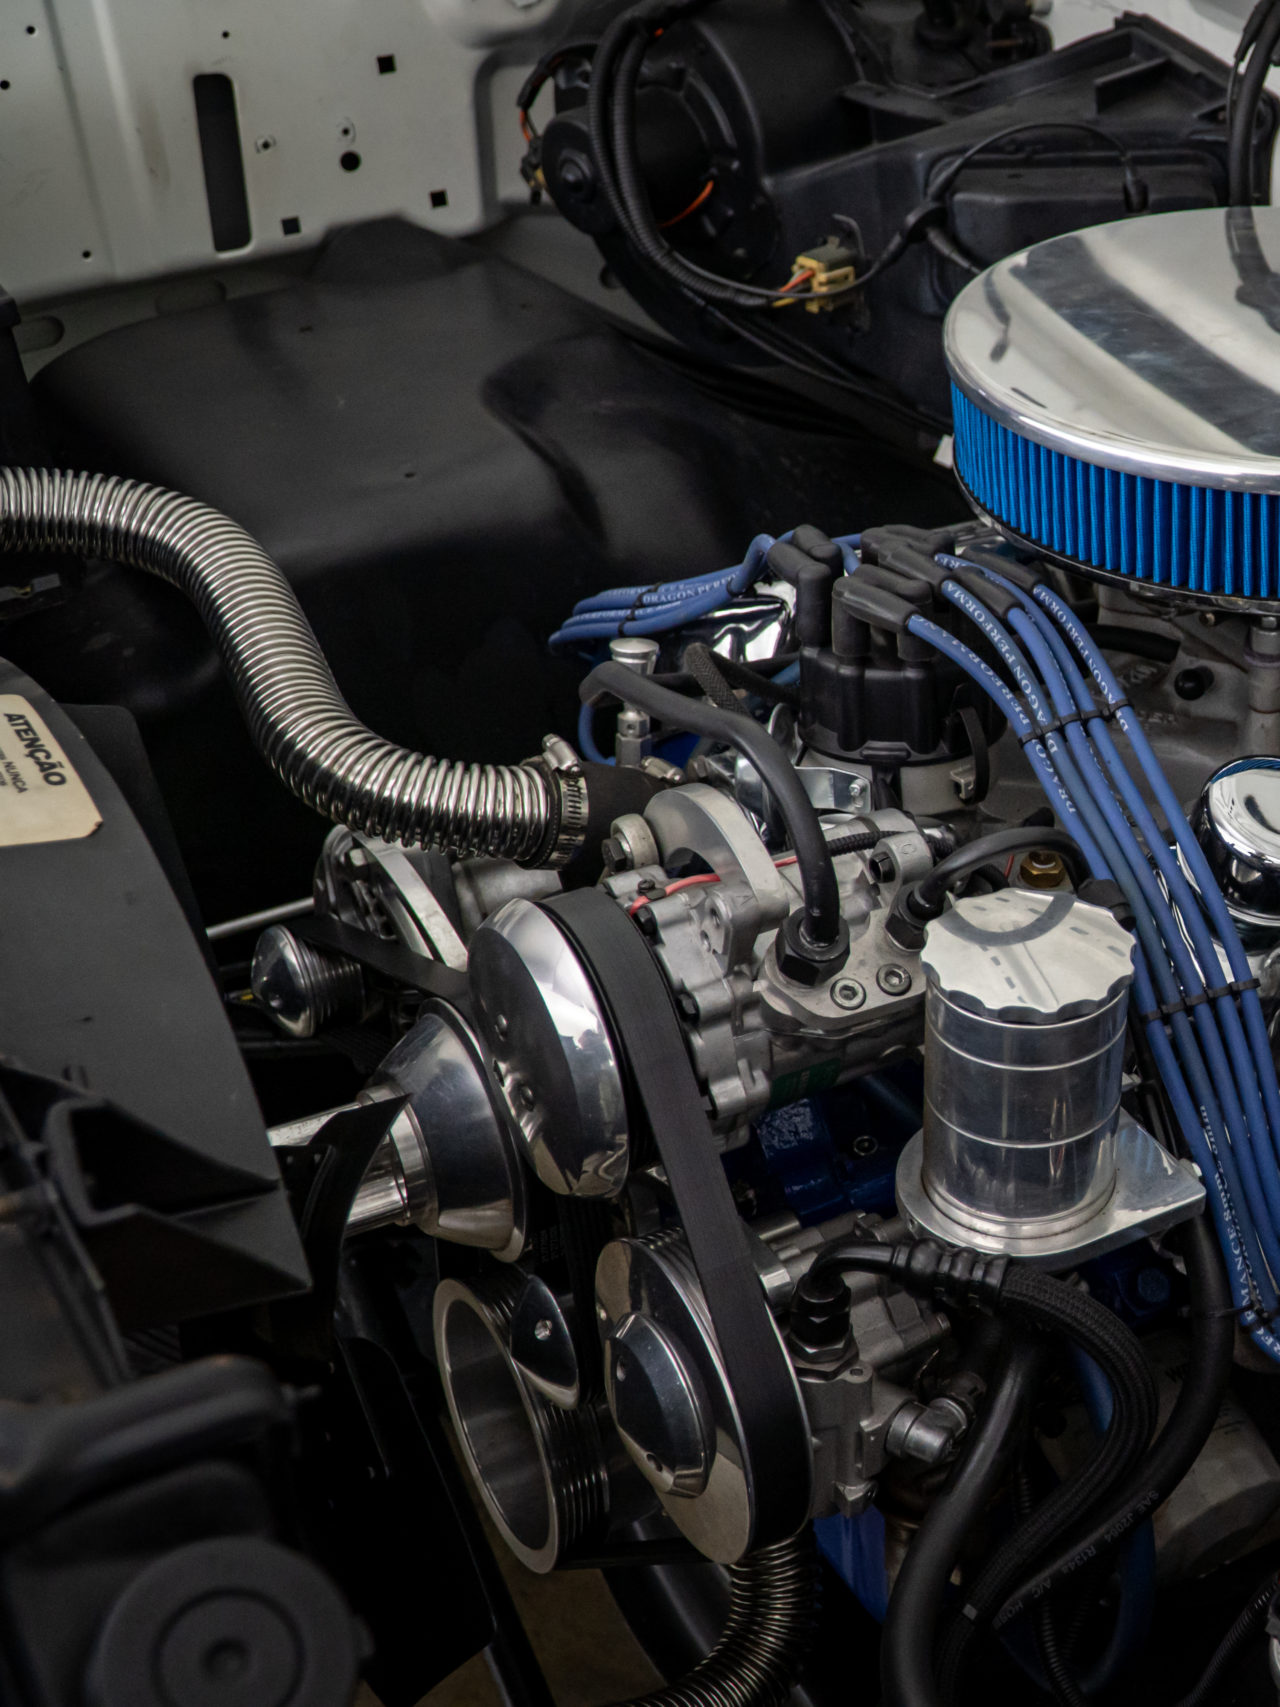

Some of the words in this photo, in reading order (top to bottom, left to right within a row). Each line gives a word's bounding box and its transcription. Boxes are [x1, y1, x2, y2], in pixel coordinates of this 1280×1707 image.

[643, 587, 697, 604] DRAGON
[1012, 665, 1059, 752] DAGON
[3, 712, 67, 786] ATENÇÃO
[3, 761, 28, 794] NUNCA
[1032, 738, 1077, 814] DRAGO
[1135, 1489, 1160, 1514] SAE
